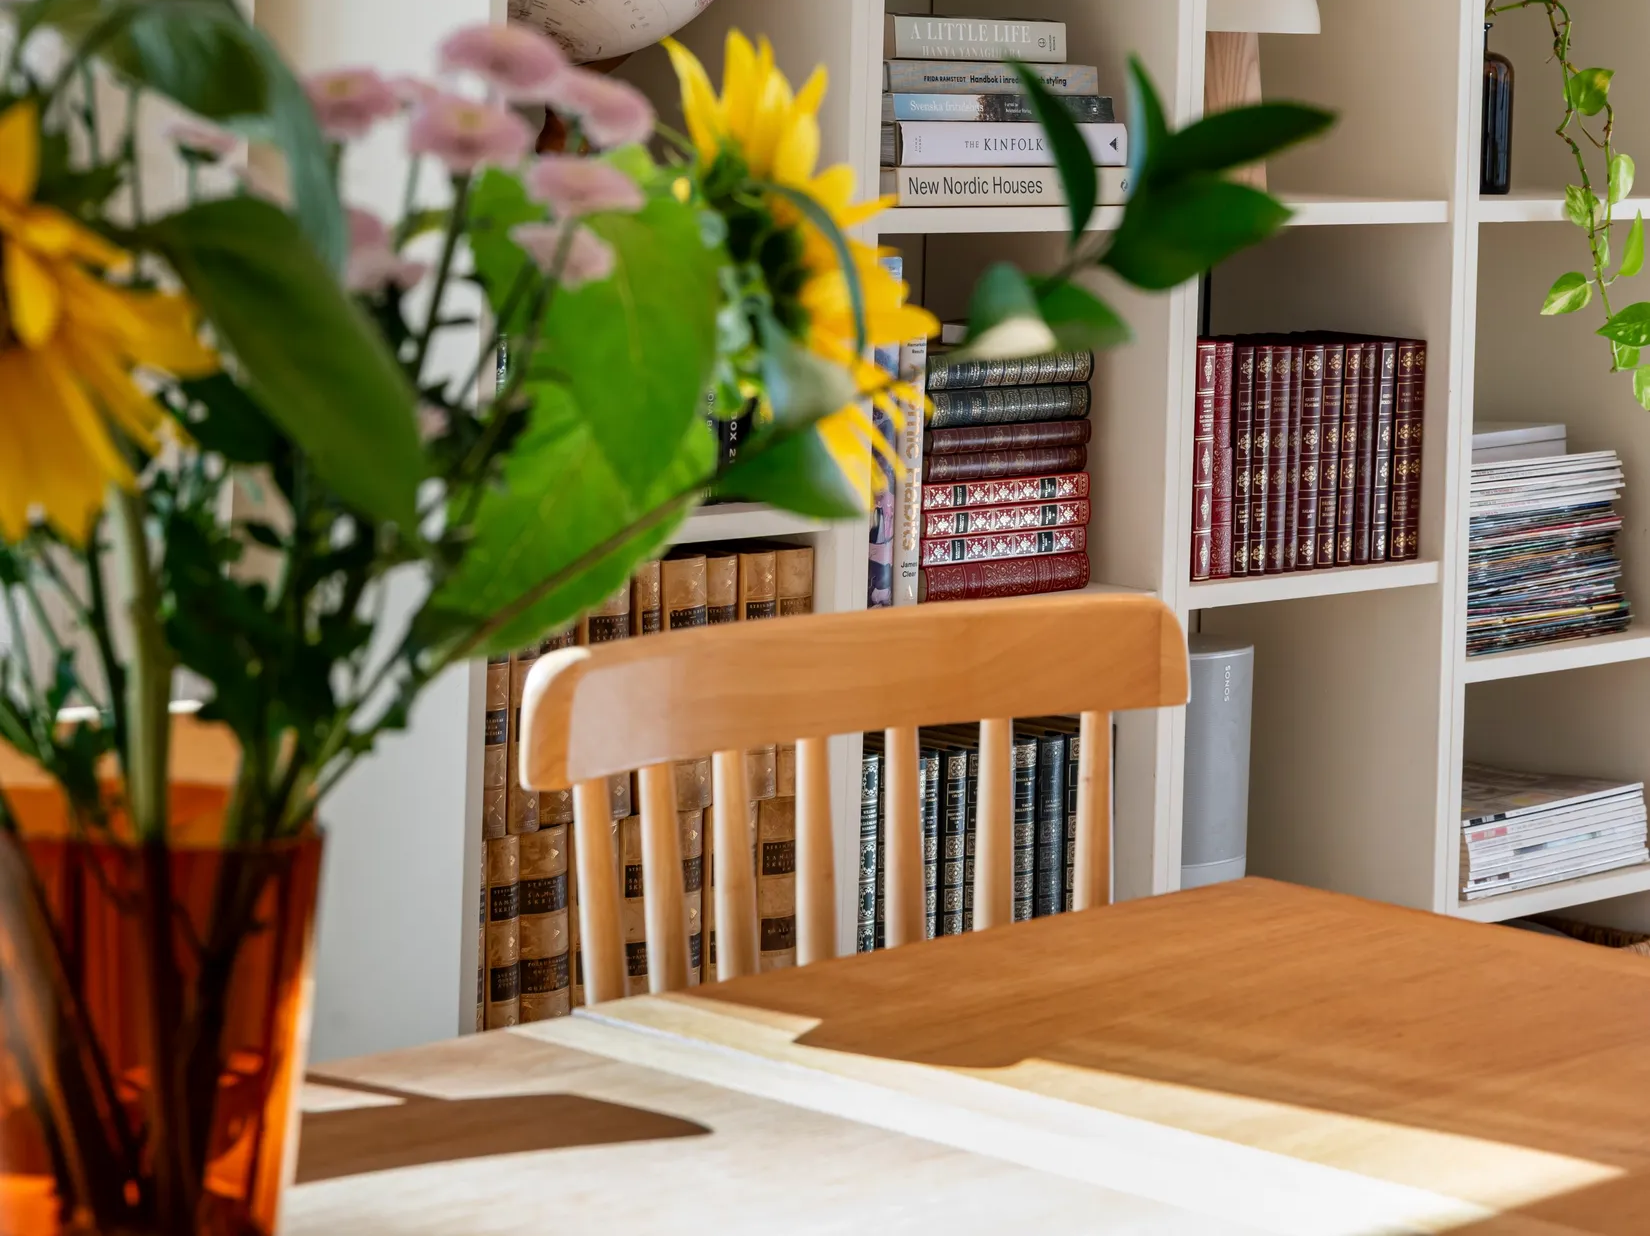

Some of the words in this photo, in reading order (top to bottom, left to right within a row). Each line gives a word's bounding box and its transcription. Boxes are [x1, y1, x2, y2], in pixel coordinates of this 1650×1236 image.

[911, 22, 921, 40] A
[927, 22, 989, 42] LITTLE
[991, 24, 1032, 43] LIFE
[922, 45, 956, 57] HANYA
[940, 75, 967, 83] RAMSTEDT
[970, 74, 998, 84] Handbok
[1046, 76, 1067, 87] styling
[910, 100, 943, 112] Svenska
[964, 140, 980, 149] THE
[984, 138, 1044, 151] KINFOLK
[909, 176, 940, 195] New
[943, 176, 989, 194] Nordic
[993, 176, 1043, 194] Houses
[902, 570, 917, 578] Clear
